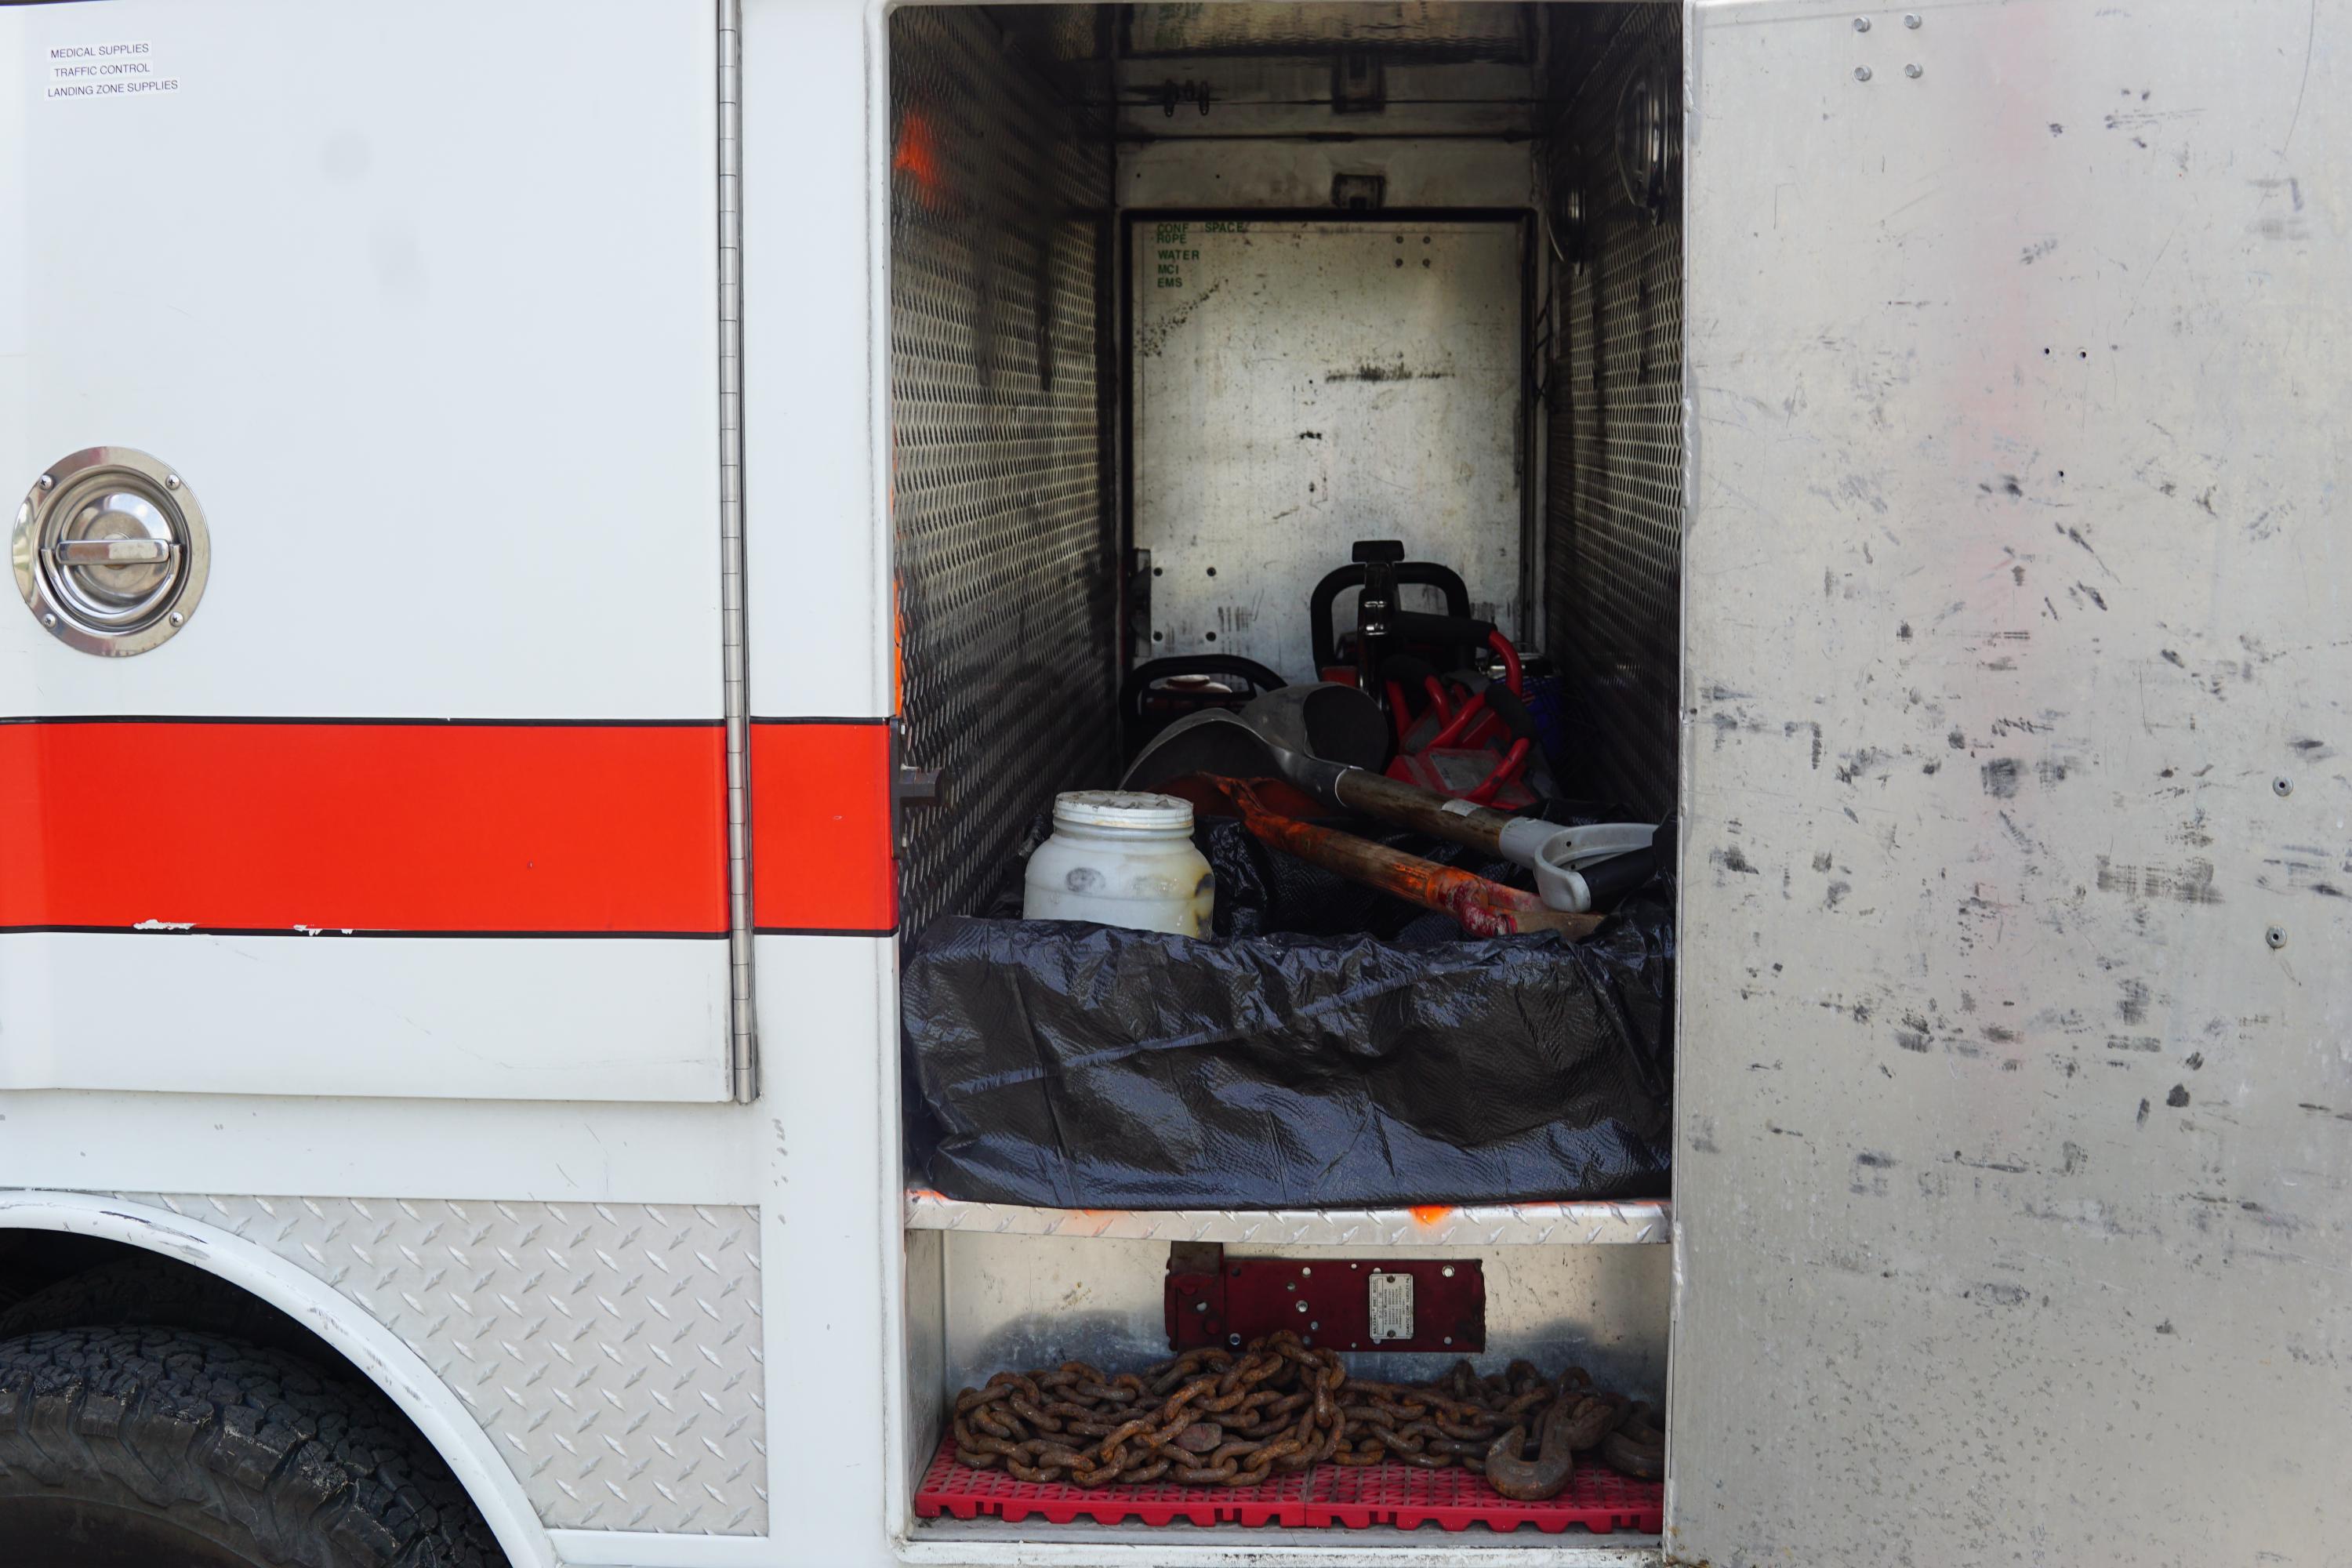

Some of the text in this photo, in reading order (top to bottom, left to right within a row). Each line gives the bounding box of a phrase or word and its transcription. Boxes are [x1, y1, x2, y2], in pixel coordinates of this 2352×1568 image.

[51, 43, 149, 59] MEDICAL SUPPLIES
[54, 63, 151, 78] TRAFFIC CONTROL
[48, 80, 178, 97] LANDING ZONE SUPPLIES
[1157, 223, 1243, 234] CONF SPACE
[1157, 250, 1200, 260] WATER
[1158, 264, 1179, 274] MCI
[1157, 278, 1182, 288] EMS
